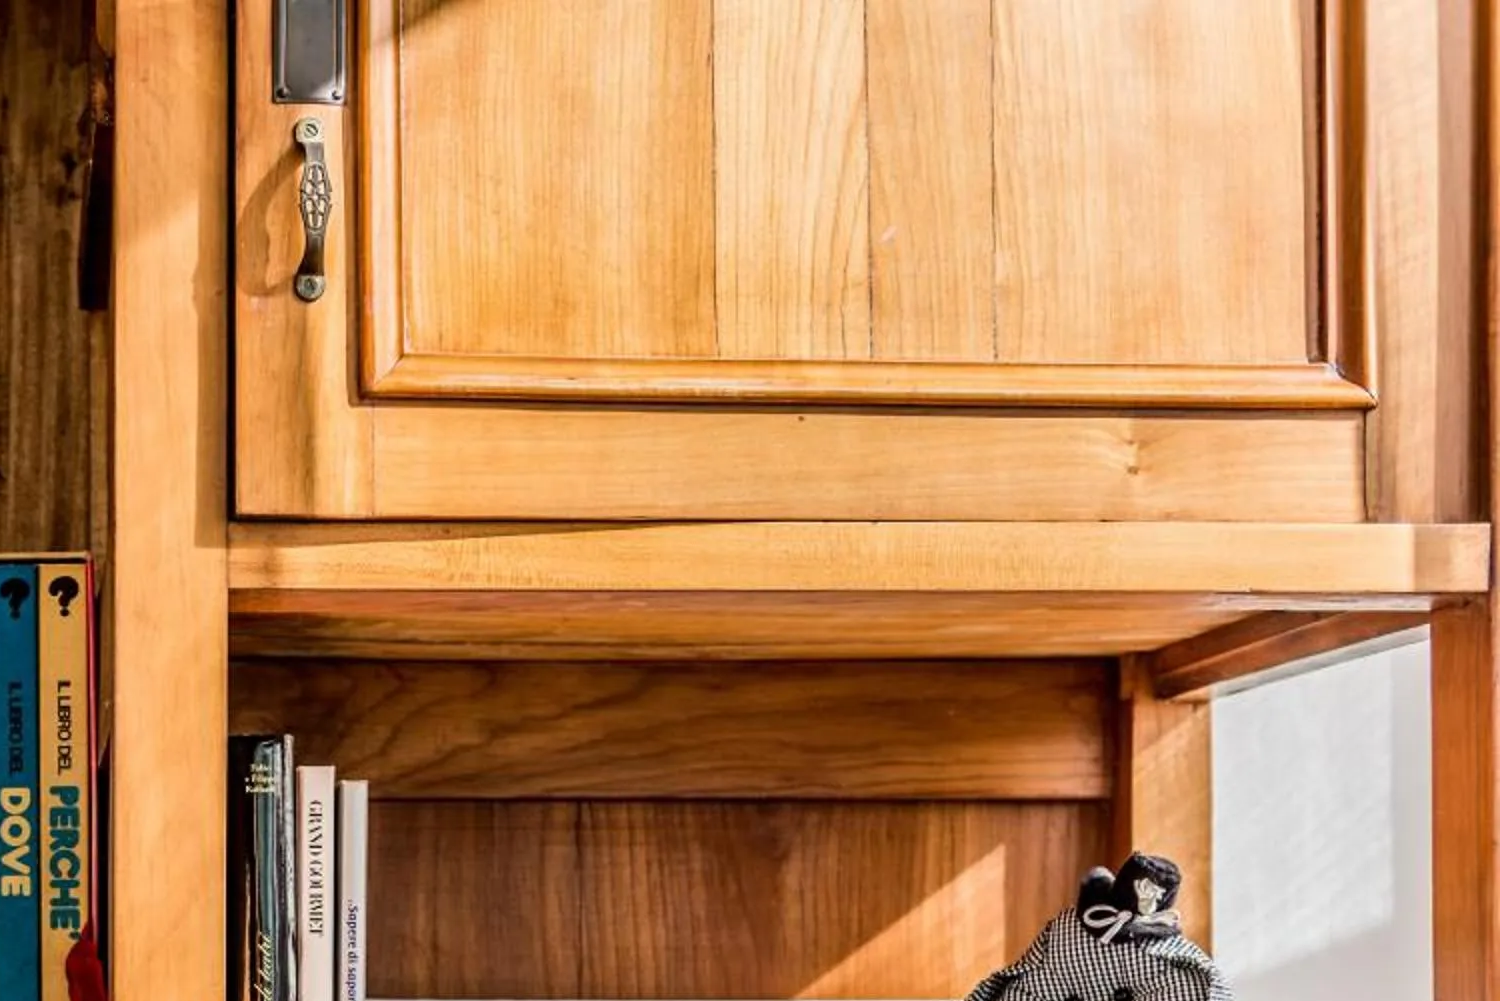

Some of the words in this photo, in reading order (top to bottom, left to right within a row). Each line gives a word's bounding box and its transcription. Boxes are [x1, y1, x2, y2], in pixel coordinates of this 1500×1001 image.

[8, 682, 23, 695] IL
[57, 680, 72, 693] IL
[8, 697, 23, 743] LIBRO
[57, 695, 72, 740] LIBRO
[8, 746, 23, 775] DEL
[57, 744, 71, 775] DEL
[0, 787, 32, 898] DOVE
[308, 799, 323, 857] GRAND
[308, 859, 323, 938] GOURMET
[347, 951, 359, 965] di
